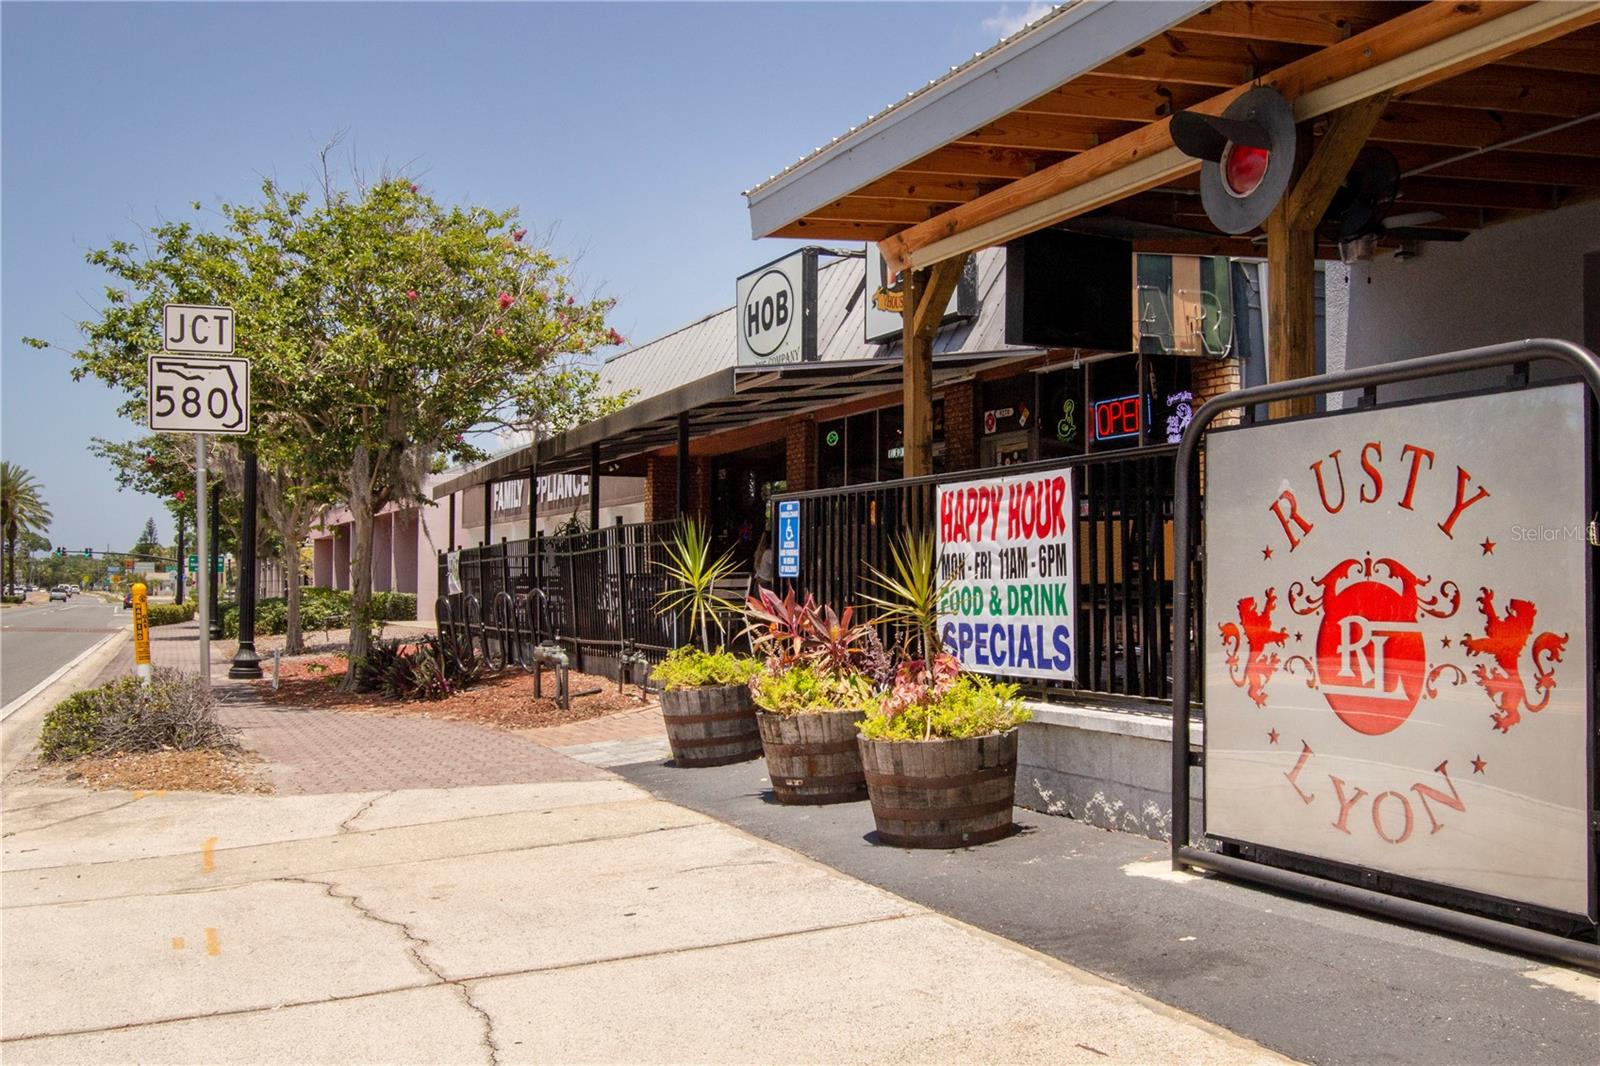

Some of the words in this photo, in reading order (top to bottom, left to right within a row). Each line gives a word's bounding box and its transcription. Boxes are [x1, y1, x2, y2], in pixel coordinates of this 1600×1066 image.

[169, 314, 229, 345] JCT
[747, 289, 789, 338] HOB
[156, 385, 228, 419] 580
[494, 479, 524, 511] FAMILY
[940, 485, 1003, 544] HAPPY
[1008, 475, 1066, 541] HOUR
[1269, 440, 1491, 553] RUSTY
[942, 551, 965, 581] MON
[974, 550, 992, 579] FRI
[999, 547, 1028, 580] 11AM
[1039, 543, 1067, 578] 6PM
[940, 585, 984, 617] FOOD
[989, 585, 1002, 616] &
[1007, 583, 1068, 616] DRINK
[941, 621, 1071, 672] SPECIALS
[1284, 739, 1467, 844] LYON
